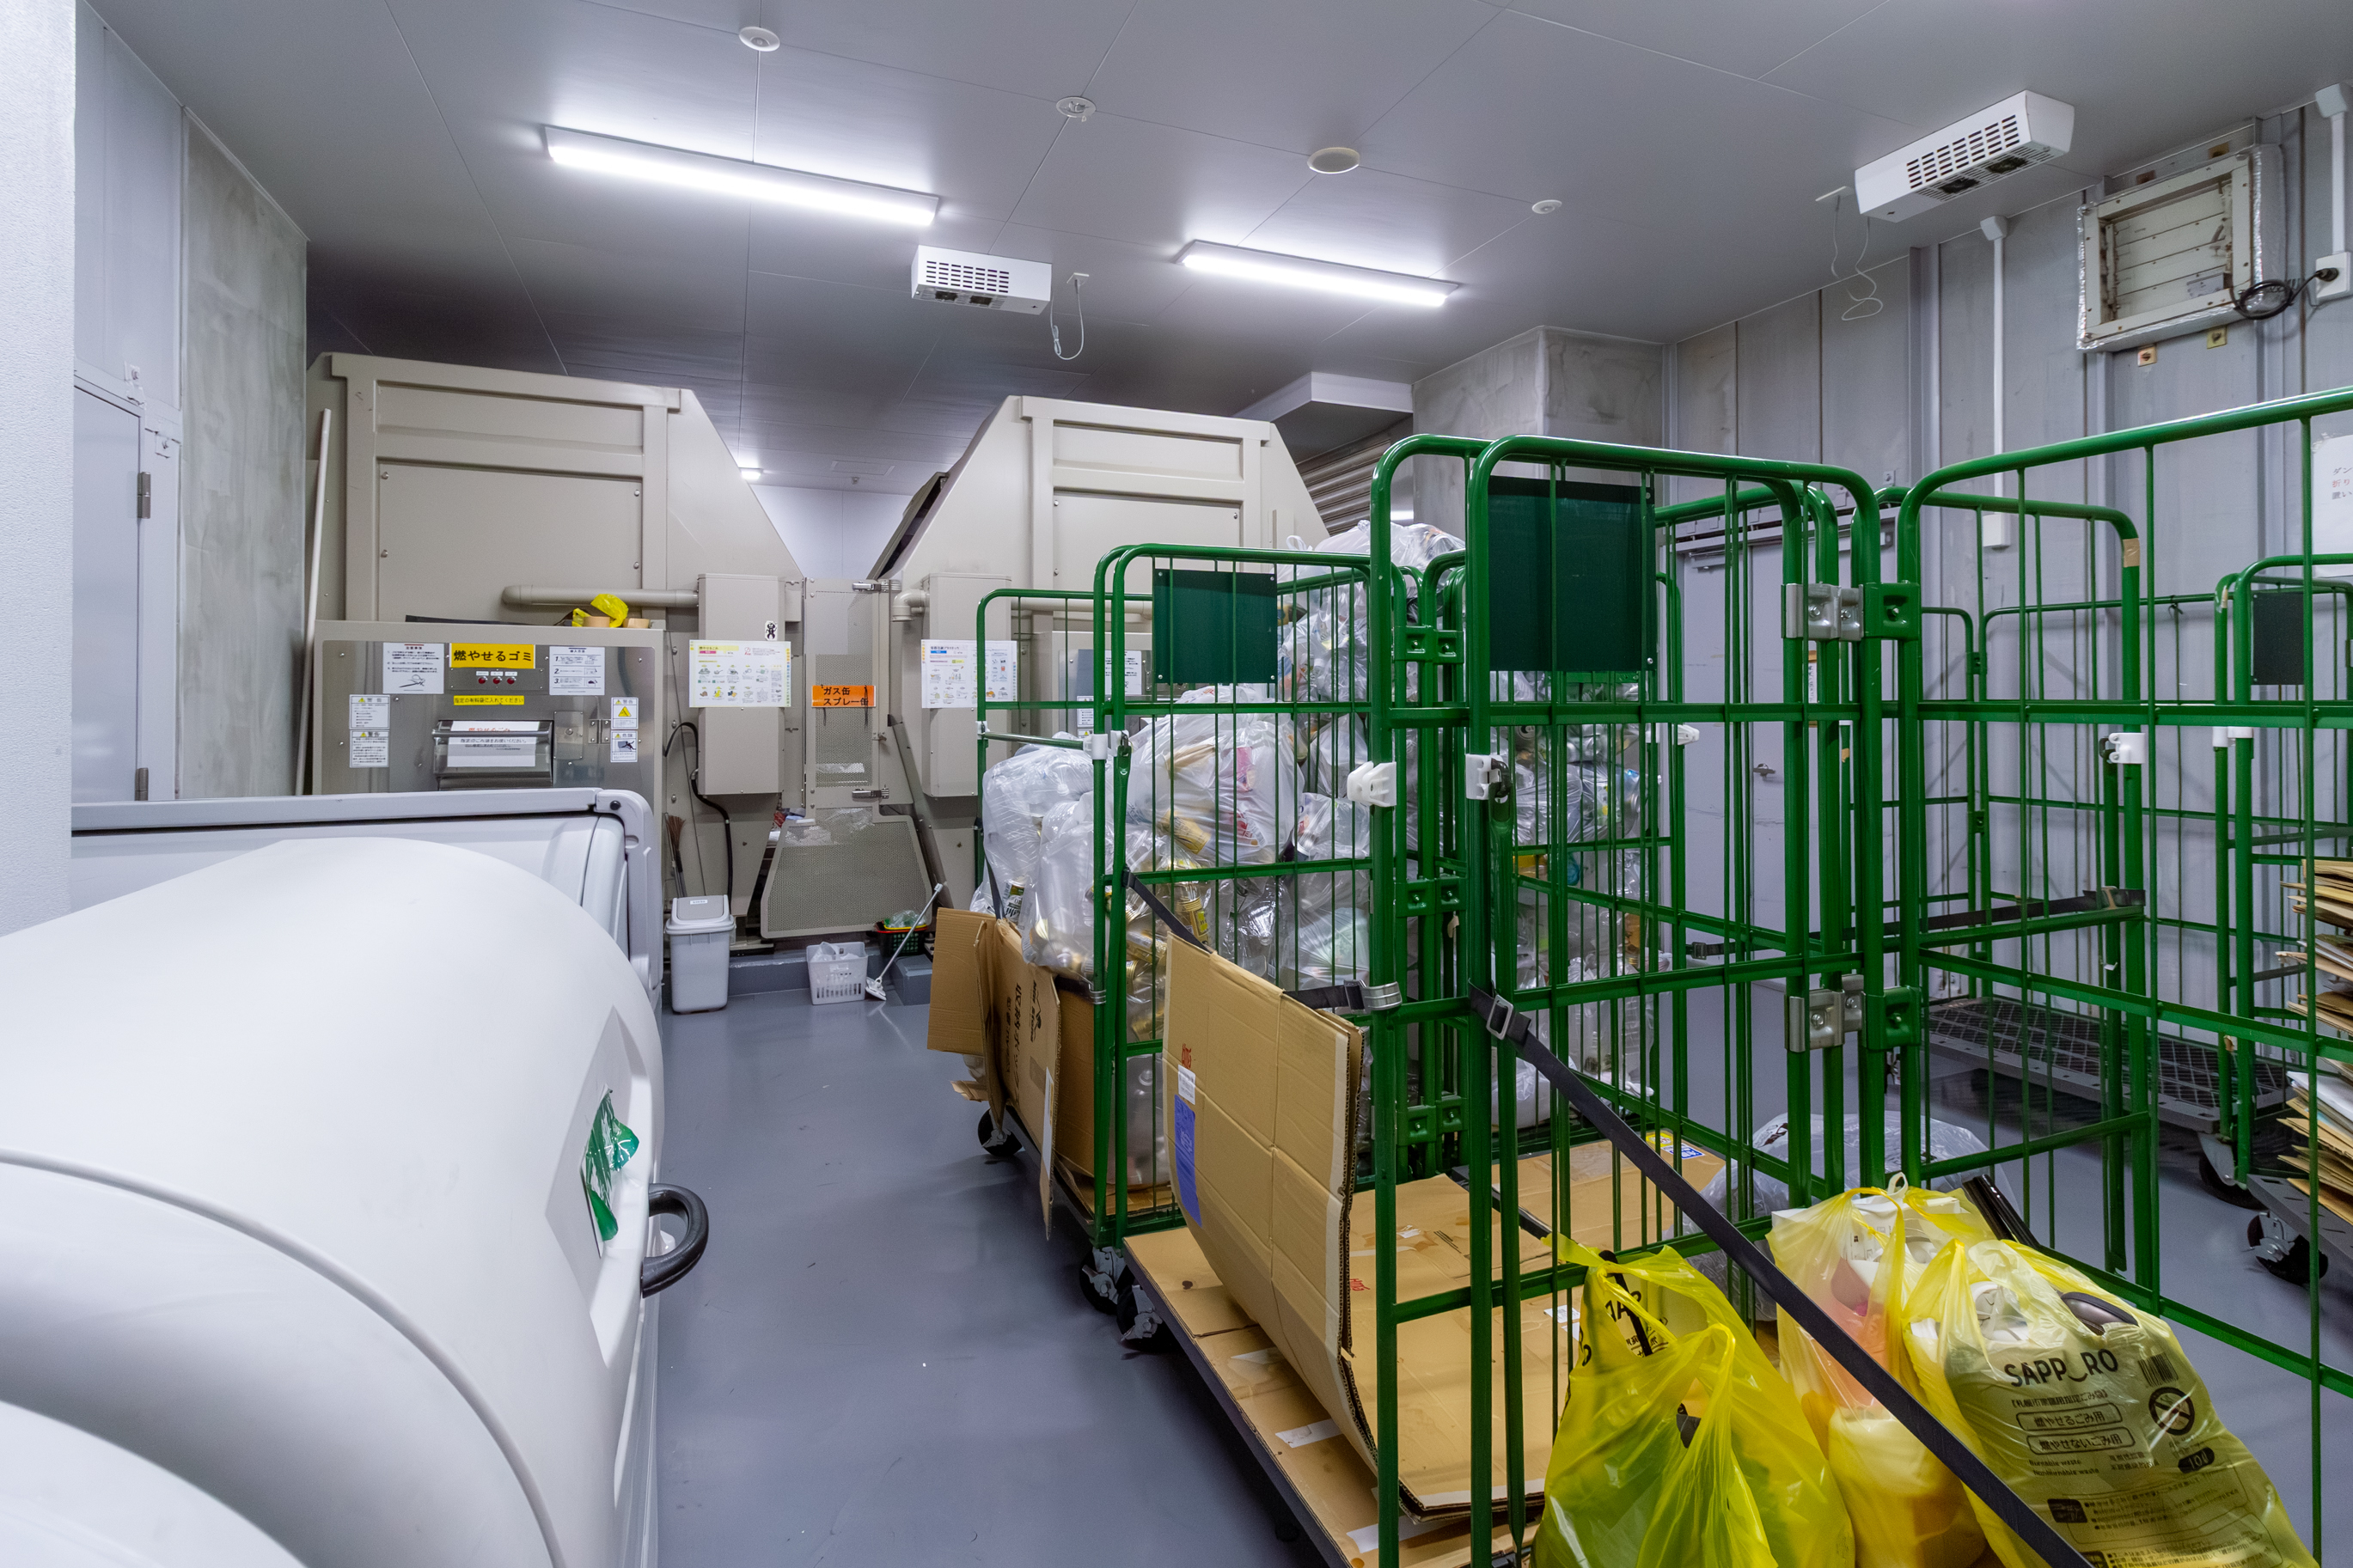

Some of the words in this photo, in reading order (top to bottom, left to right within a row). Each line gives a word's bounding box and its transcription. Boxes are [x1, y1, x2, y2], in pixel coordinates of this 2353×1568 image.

[453, 650, 532, 662] 燃やせるゴミ
[823, 687, 851, 696] ガス缶
[823, 697, 869, 705] スプレー缶
[2033, 1411, 2105, 1428] 燃やせるごみ用
[2038, 1433, 2123, 1451] 燃やせないごみ用
